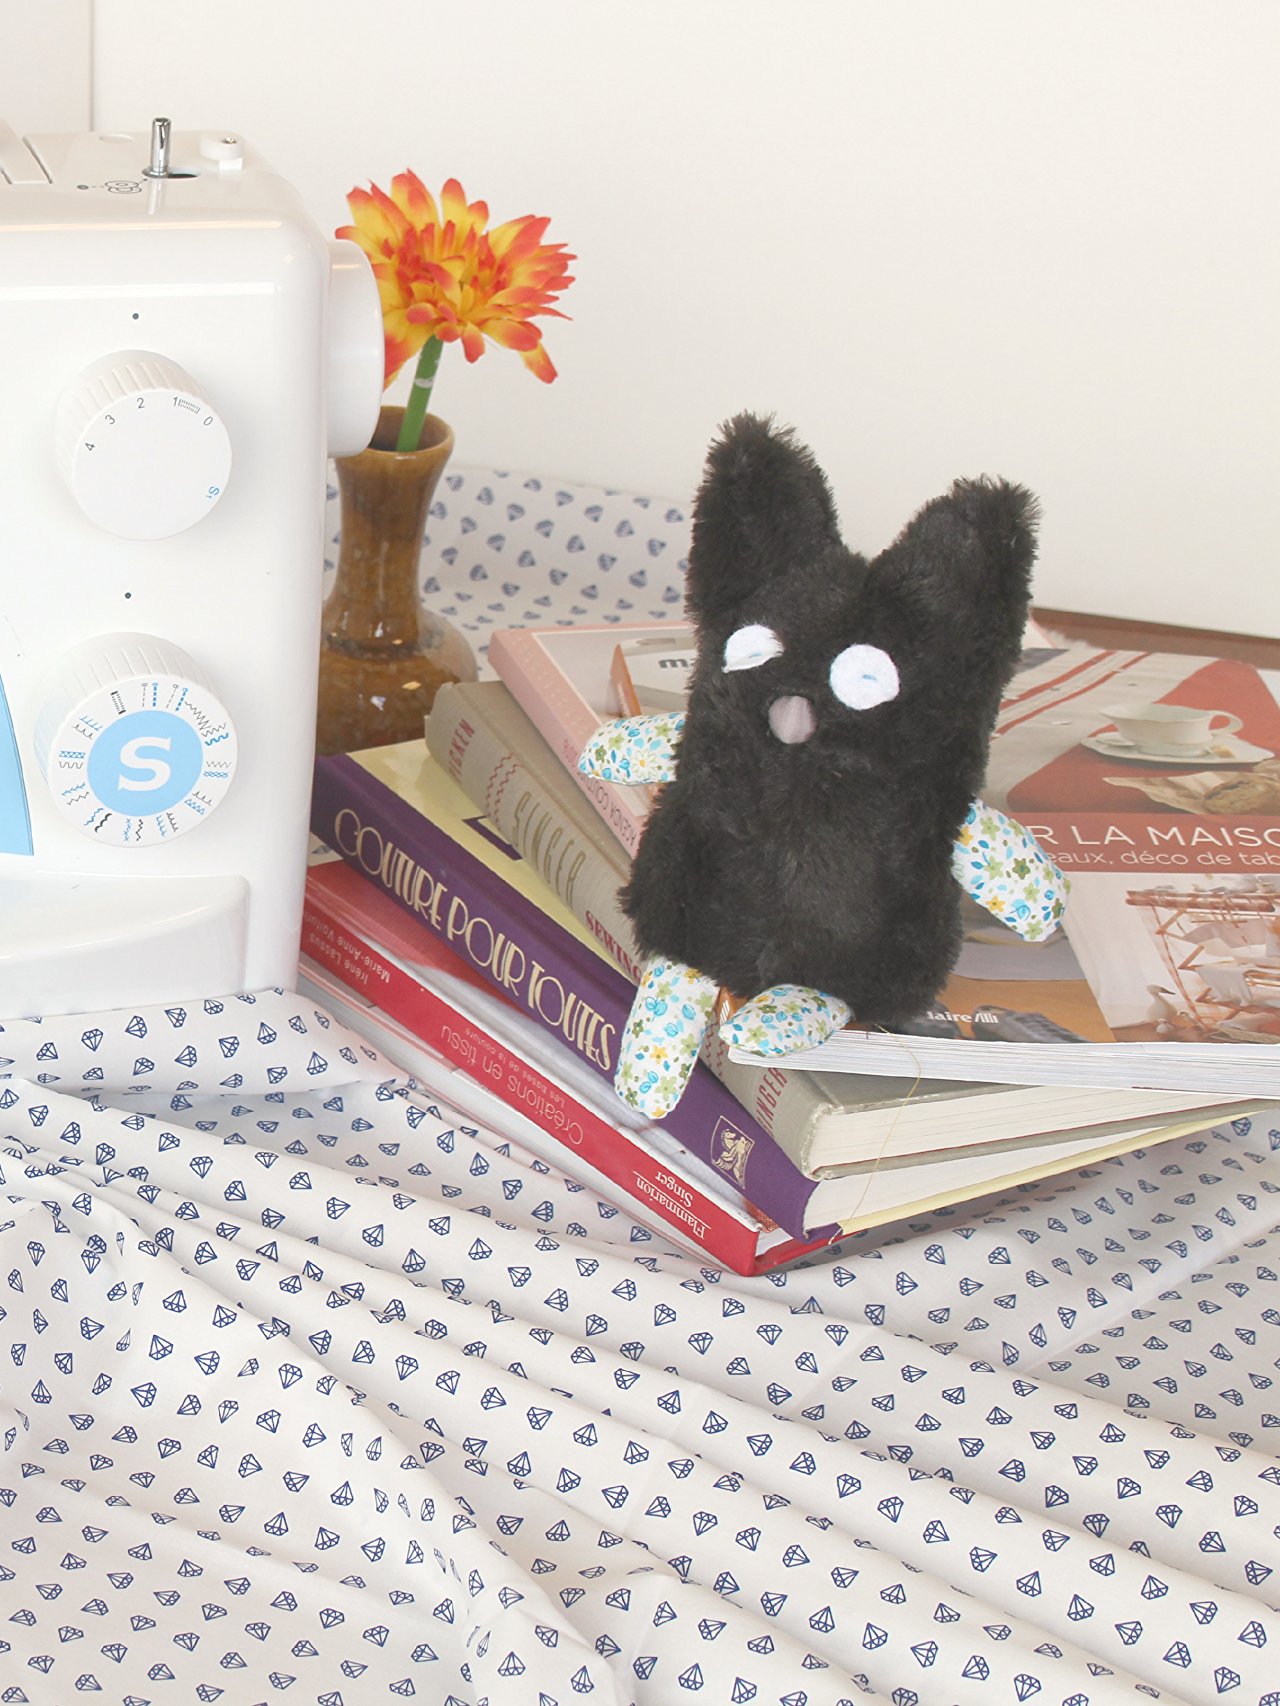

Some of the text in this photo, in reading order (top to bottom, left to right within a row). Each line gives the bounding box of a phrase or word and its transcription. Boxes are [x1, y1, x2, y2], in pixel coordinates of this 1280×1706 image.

[84, 441, 96, 452] 4
[104, 414, 116, 425] 3
[136, 397, 146, 409] 2
[203, 416, 214, 426] 0
[117, 735, 172, 792] S
[512, 790, 587, 912] SINGER
[1046, 852, 1114, 865] eaux,
[1120, 850, 1189, 866] déco
[1196, 851, 1232, 866] de
[1070, 825, 1136, 845] LA
[334, 808, 616, 1072] COUTURE POUR TOUTES
[337, 936, 391, 984] Marie-Anne
[925, 1010, 973, 1023] laire
[441, 1025, 584, 1145] Créations en tissu
[465, 1027, 566, 1108] Les bases de la couture
[635, 1177, 706, 1240] Flammarion
[654, 1171, 694, 1208] Singer
